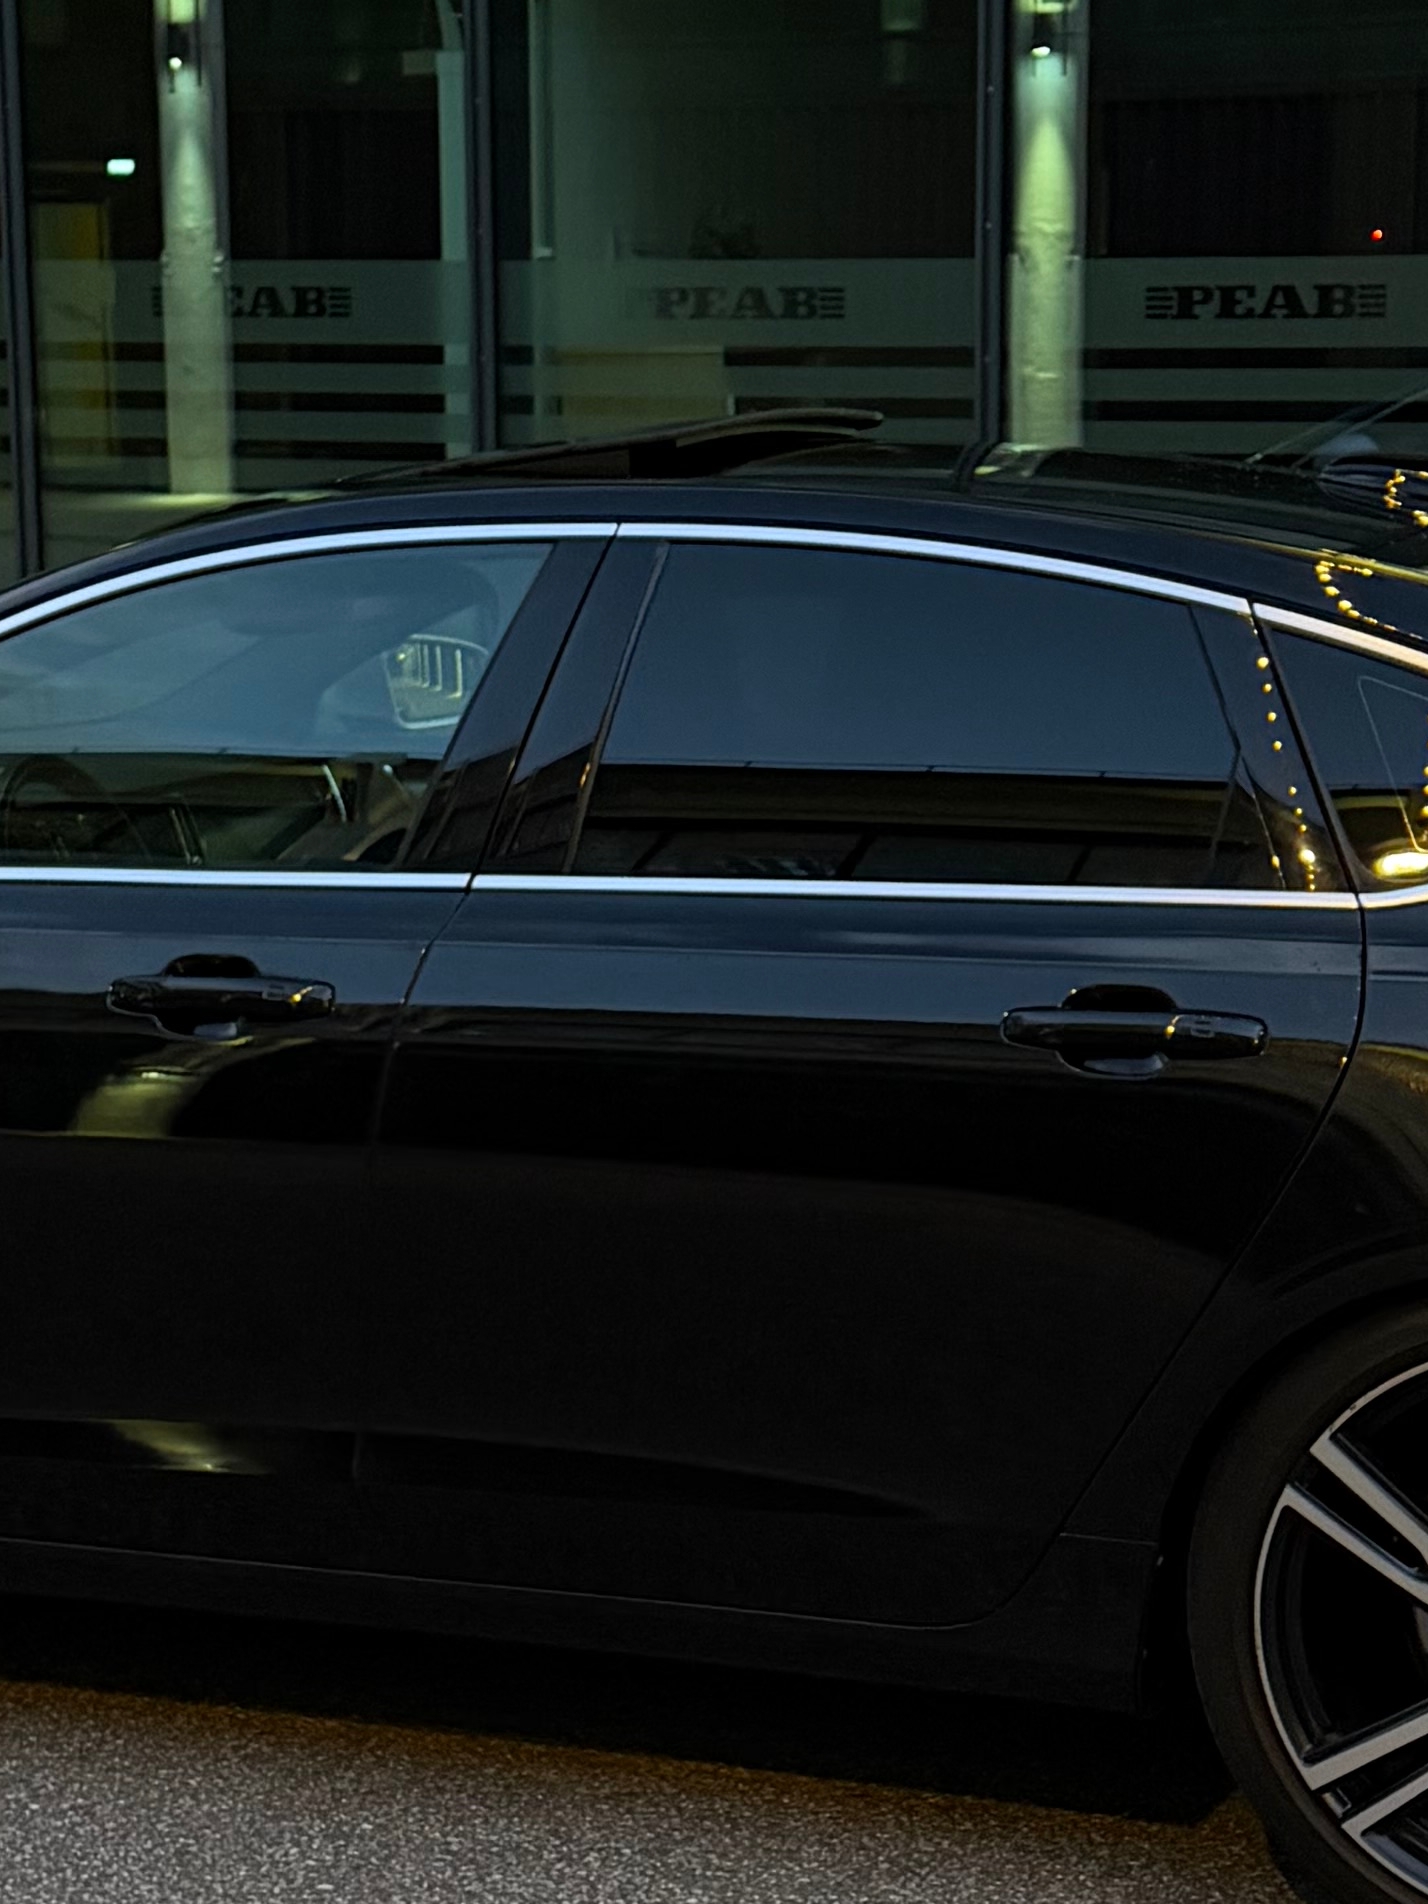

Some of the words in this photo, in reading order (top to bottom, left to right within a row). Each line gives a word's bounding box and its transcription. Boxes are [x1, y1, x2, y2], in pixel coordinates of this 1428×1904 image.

[227, 285, 328, 318] EAB
[653, 285, 819, 319] PEAB
[1168, 284, 1360, 321] PEAB
